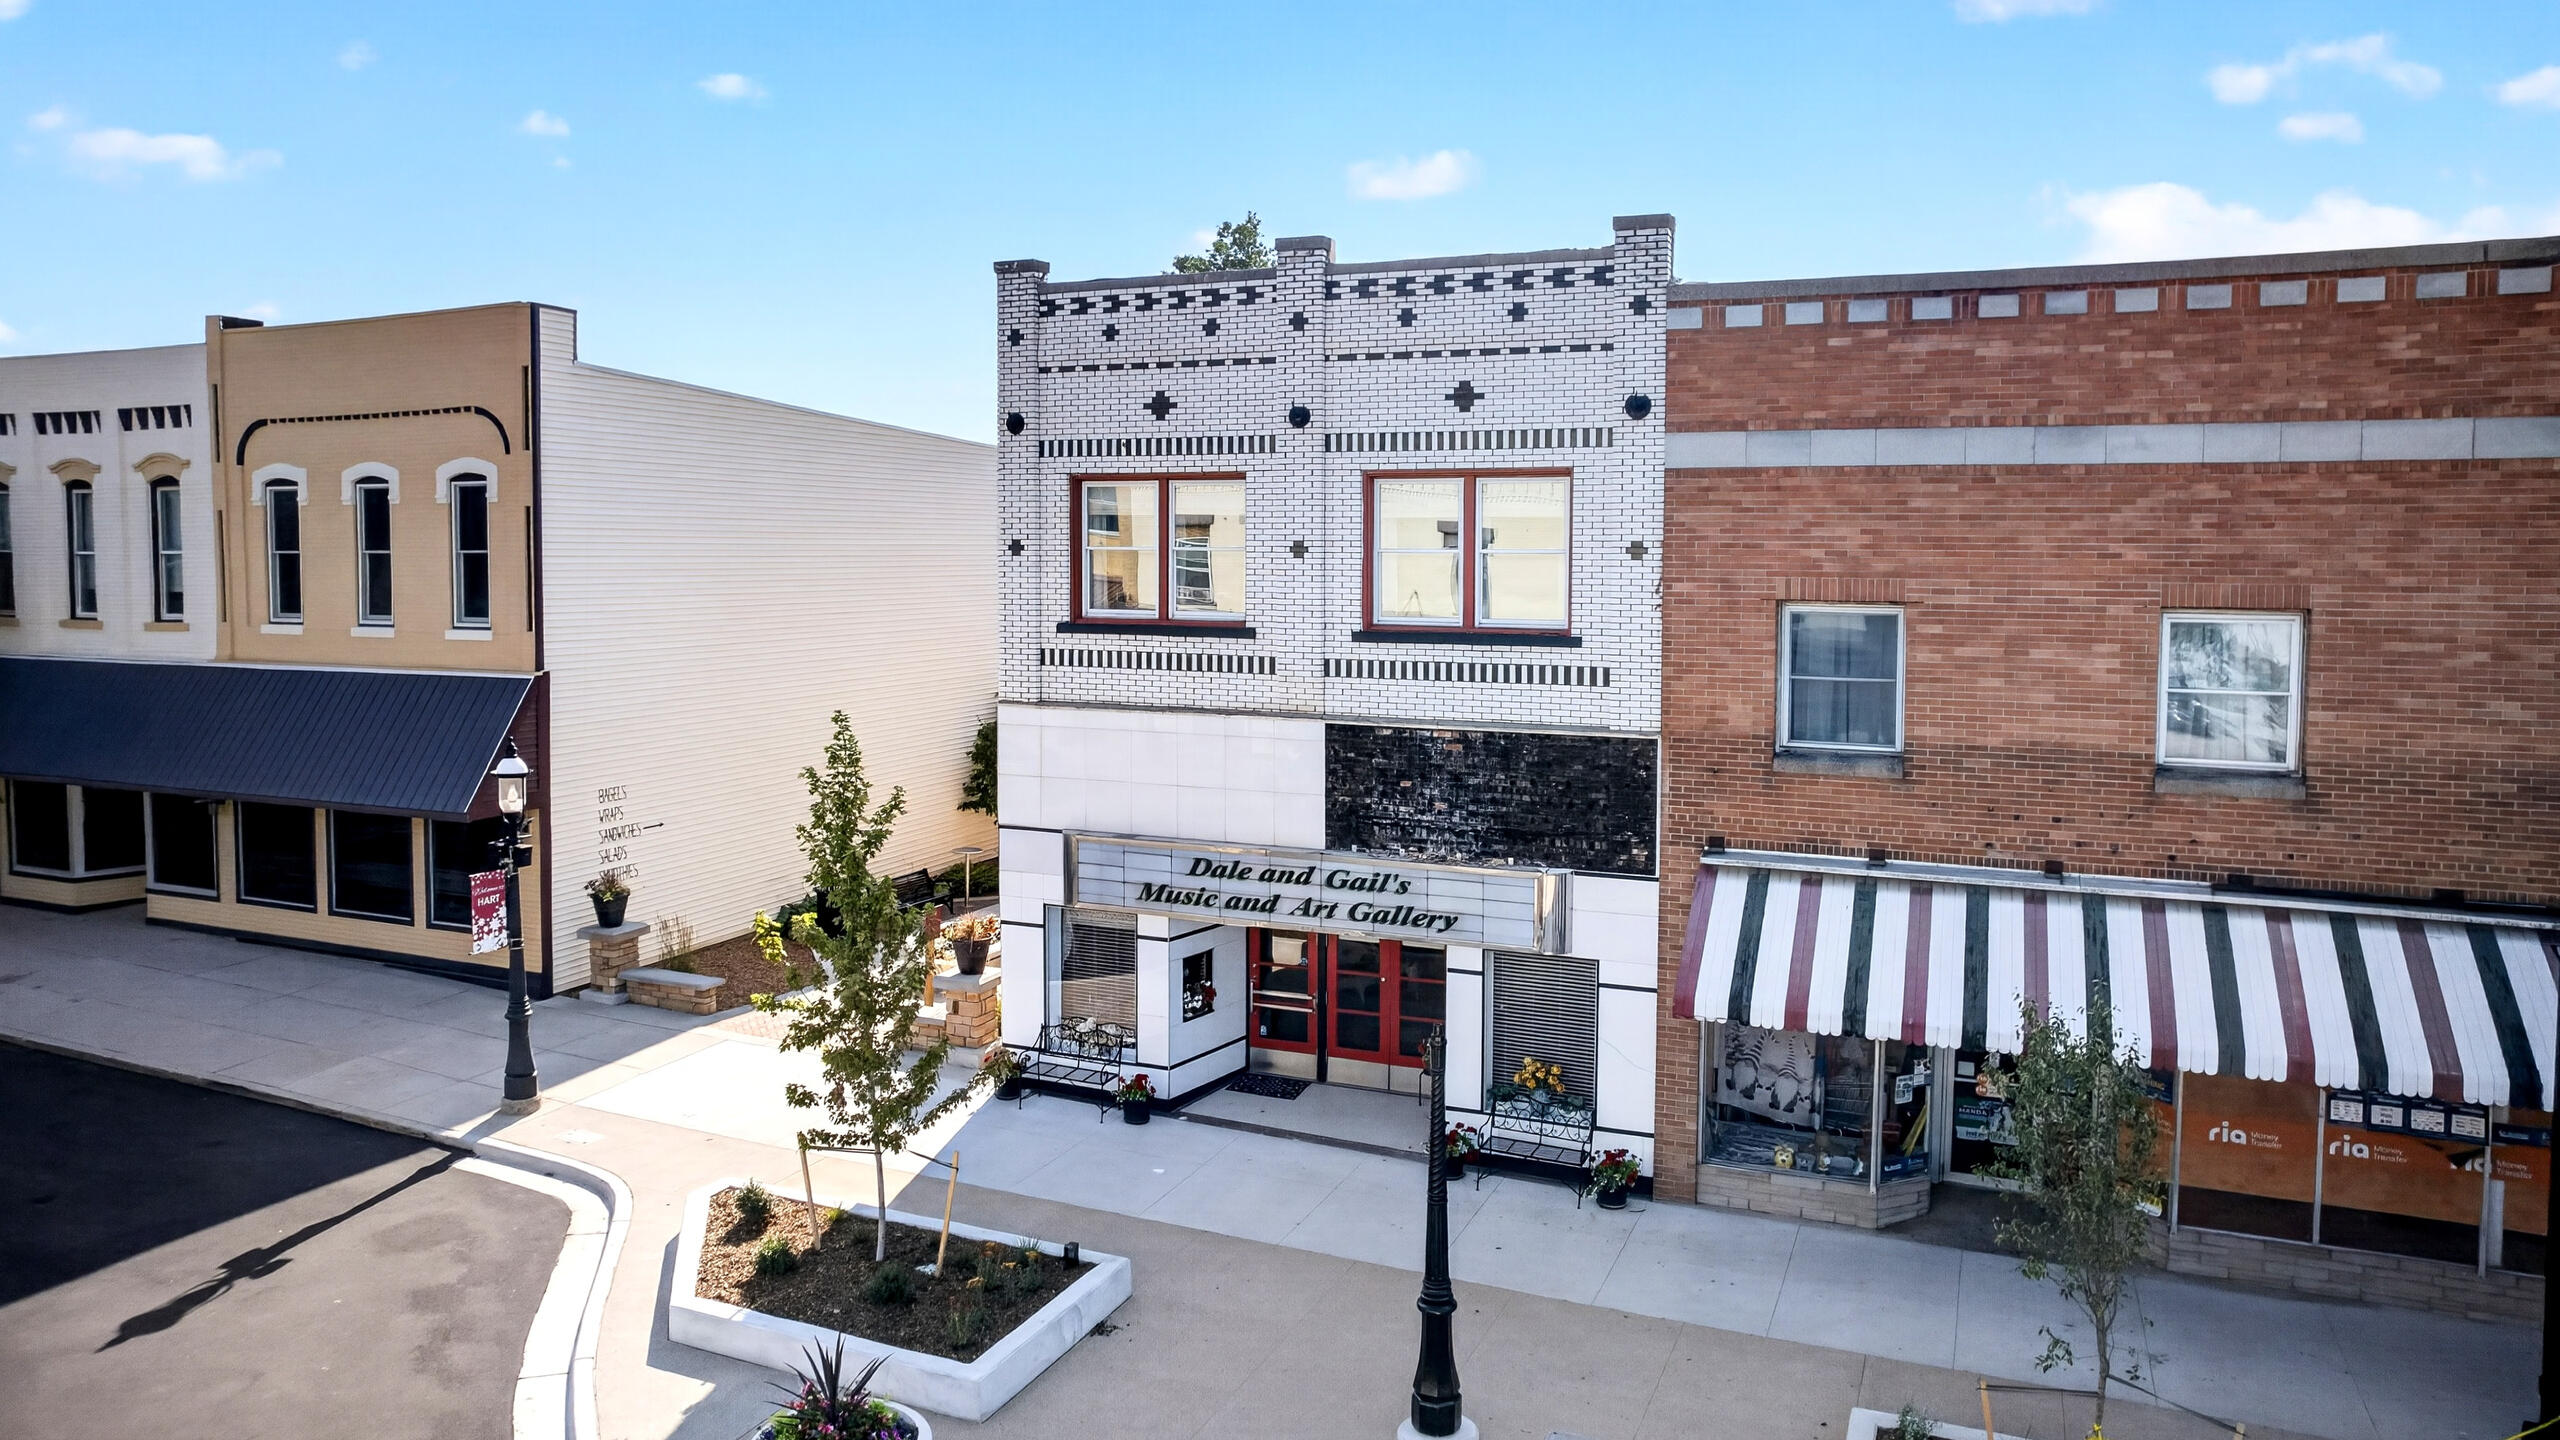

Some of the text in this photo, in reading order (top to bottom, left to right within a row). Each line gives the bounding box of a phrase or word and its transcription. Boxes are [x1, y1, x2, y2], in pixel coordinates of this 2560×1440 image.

[598, 785, 627, 803] BAGELS
[598, 805, 624, 823] WRAPS
[598, 823, 641, 844] SANDWICHES
[598, 845, 627, 864] SALADS
[1185, 857, 1411, 895] Dale and Gail's
[477, 894, 500, 907] HART
[1136, 882, 1458, 933] Music and Art Gallery
[2208, 1121, 2279, 1145] ria Money
[2251, 1139, 2282, 1150] Transfer
[2329, 1134, 2403, 1159] ria Money
[2374, 1153, 2408, 1163] Transfer
